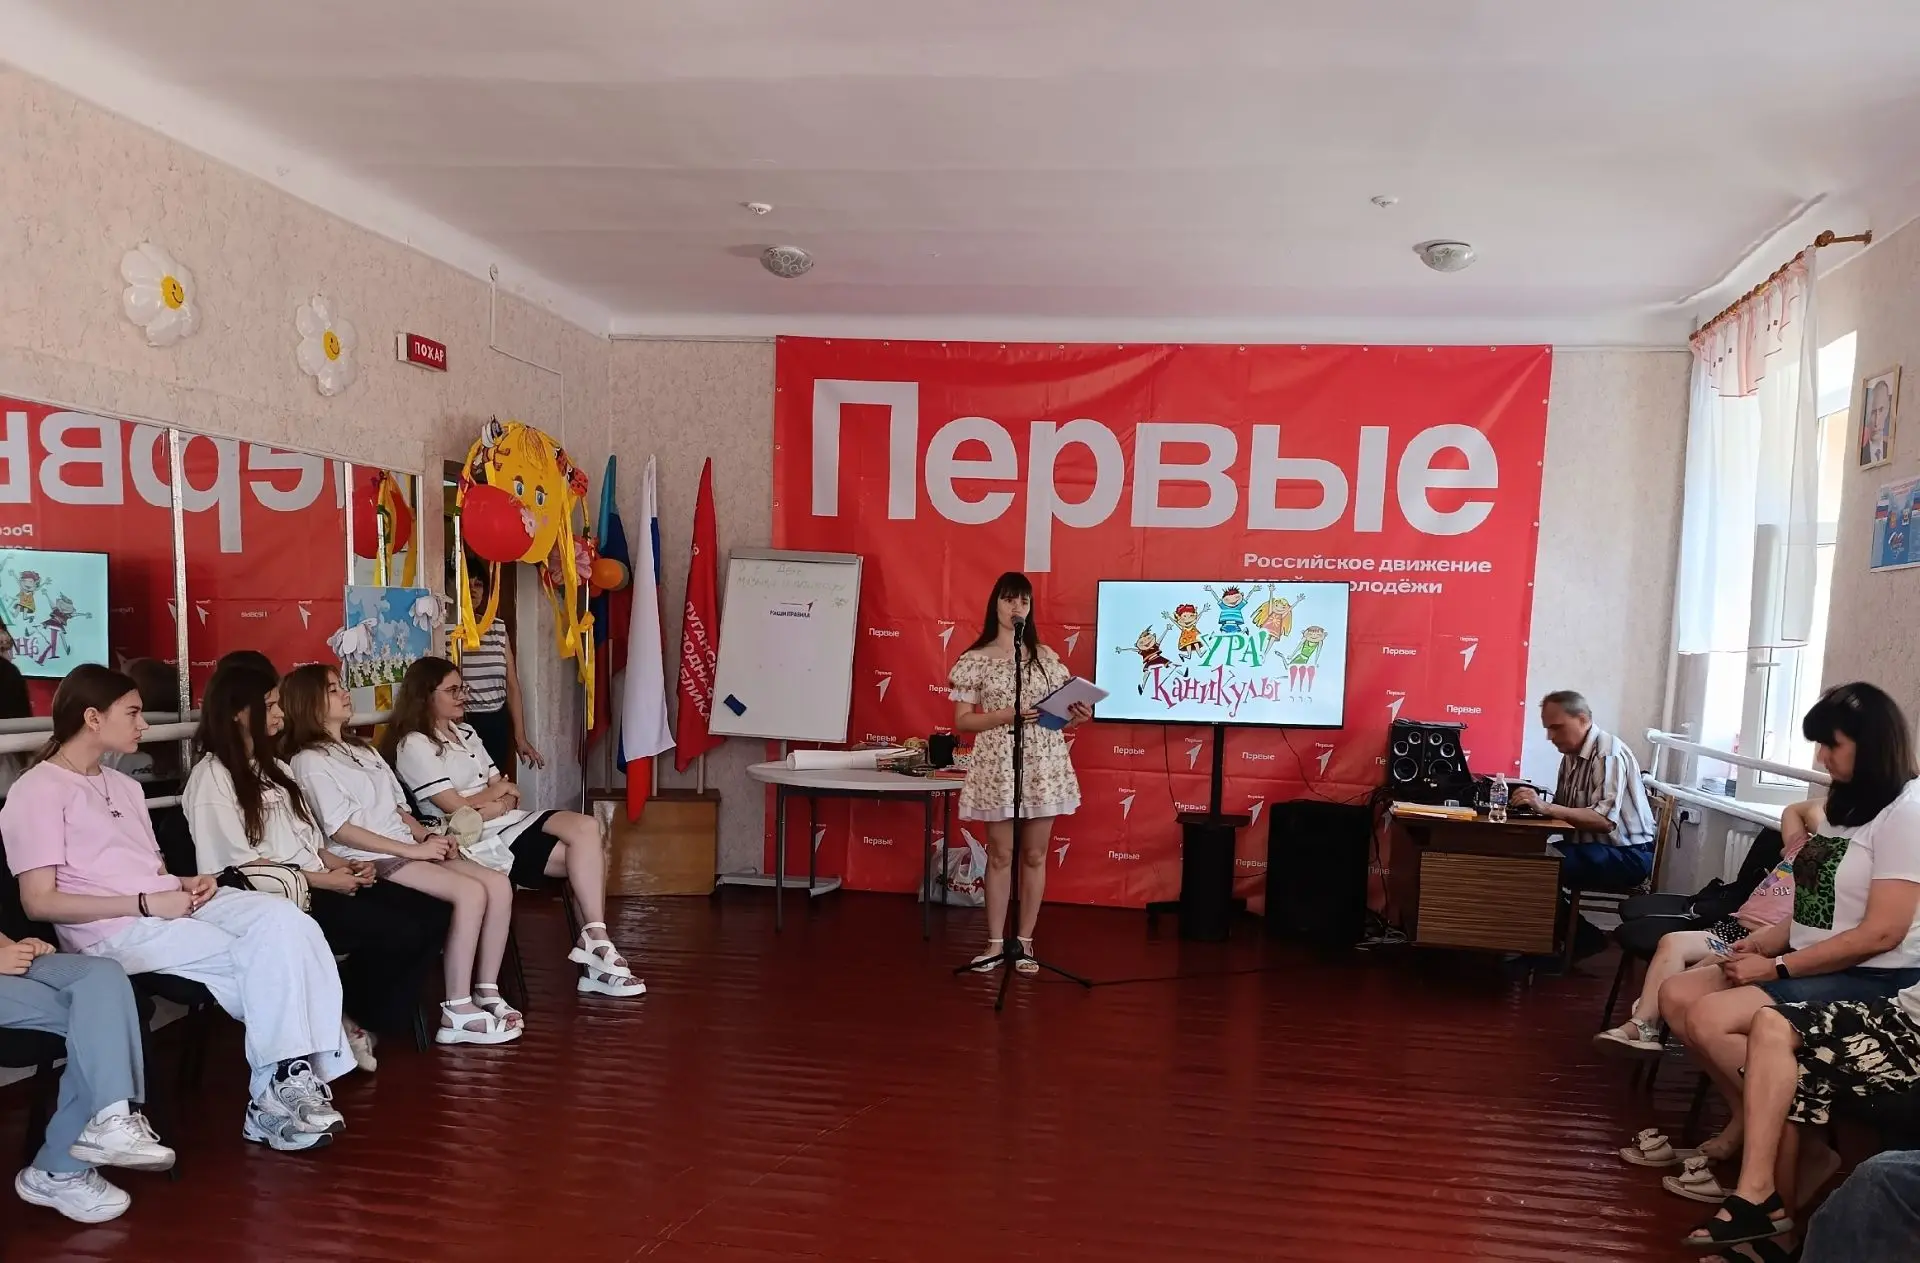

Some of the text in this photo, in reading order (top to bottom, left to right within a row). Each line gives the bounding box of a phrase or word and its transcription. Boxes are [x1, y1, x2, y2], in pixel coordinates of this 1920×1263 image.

[414, 341, 444, 362] ПОЖАР
[811, 379, 1498, 573] Первые
[1243, 553, 1493, 573] Российское движение
[1348, 578, 1443, 594] олодёжи
[869, 628, 900, 638] Первые
[1198, 630, 1269, 667] УРА!
[1382, 646, 1417, 656] Первые
[928, 685, 953, 694] Перв
[1446, 704, 1482, 715] Первые
[866, 733, 897, 743] Первые
[1113, 745, 1145, 755] Первые
[1242, 751, 1276, 761] Первые
[1174, 802, 1207, 811] Первые
[863, 836, 894, 846] Первые
[1108, 850, 1140, 860] Первые
[1235, 858, 1268, 868] Первые
[1368, 866, 1390, 875] Перв
